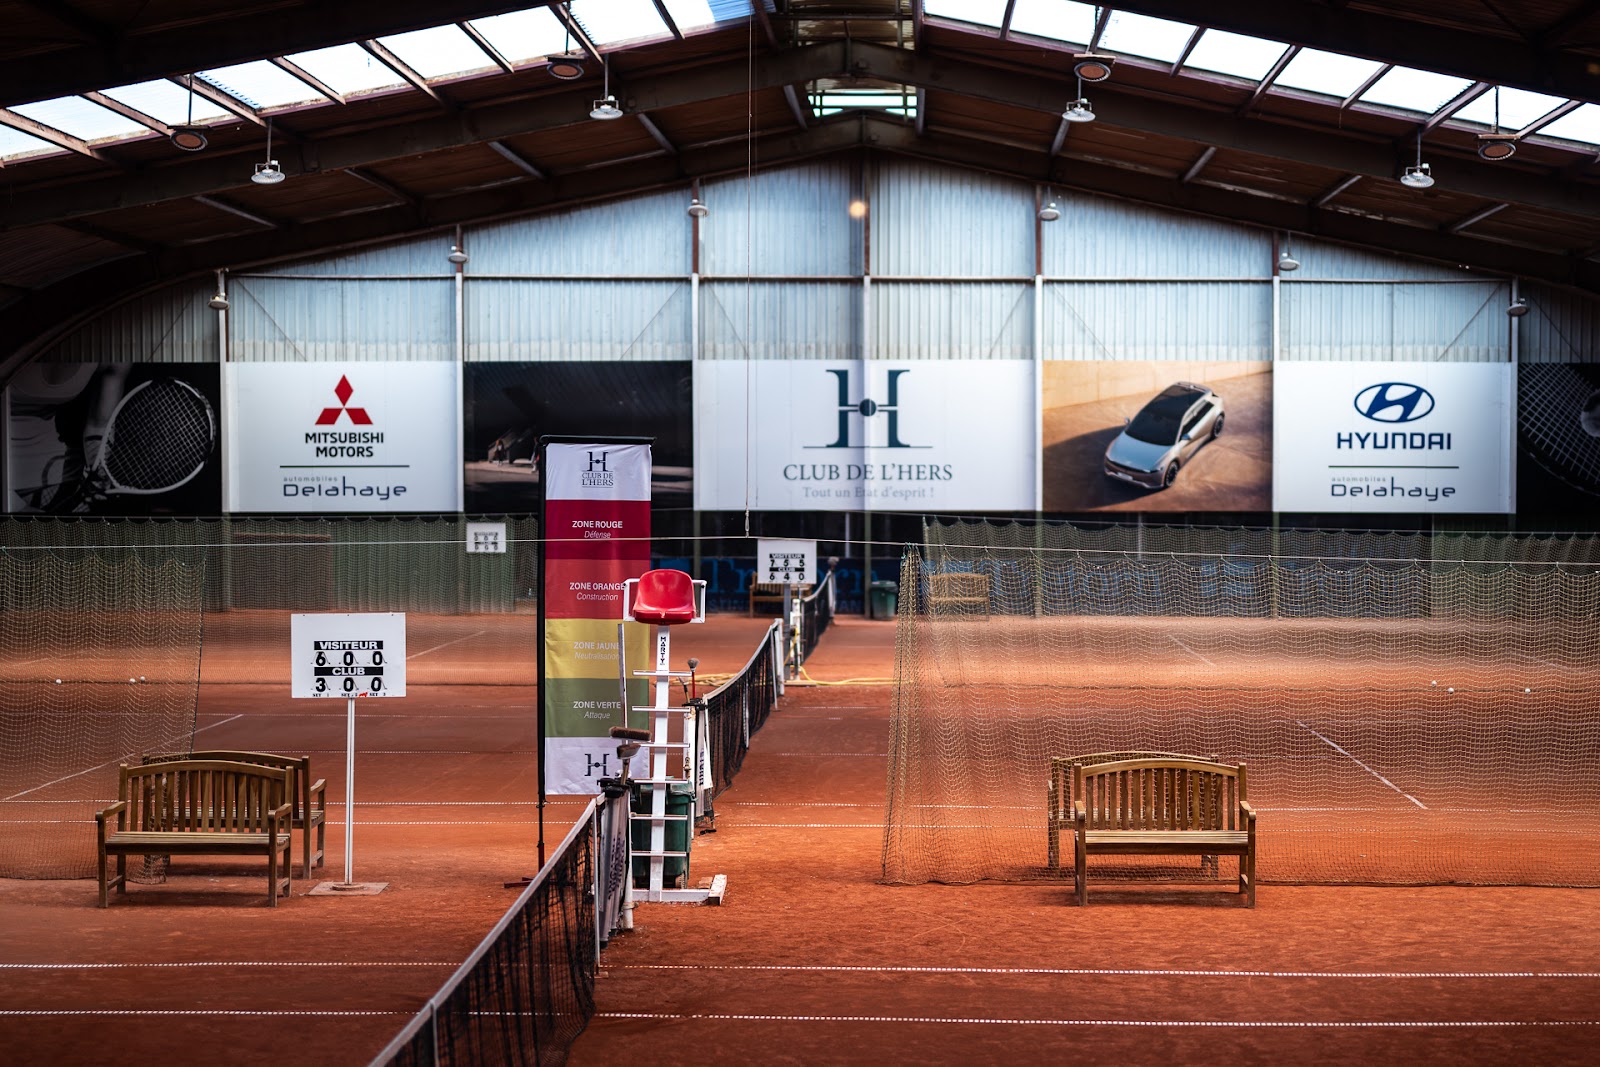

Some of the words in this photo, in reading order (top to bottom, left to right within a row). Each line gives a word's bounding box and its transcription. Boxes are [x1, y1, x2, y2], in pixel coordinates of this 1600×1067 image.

[305, 432, 385, 444] MITSUBISHI
[1336, 432, 1452, 450] HYUNDAI
[315, 446, 374, 458] MOTORS
[581, 472, 601, 480] CLUB
[783, 464, 840, 481] CLUB
[846, 464, 875, 481] DE
[881, 463, 953, 481] L'HERS
[581, 479, 614, 487] L'HERS
[283, 475, 407, 501] Delahaye
[1331, 476, 1457, 502] Delahaye
[803, 486, 831, 498] Tout
[835, 489, 850, 498] un
[881, 486, 927, 501] d'esprit
[572, 520, 594, 529] ZONE
[595, 520, 623, 529] ROUGE
[583, 530, 612, 539] Défense
[569, 582, 593, 591] ZONE
[592, 582, 625, 591] ORANGE
[576, 592, 619, 601] Construction
[319, 641, 378, 650] VISITEUR
[573, 641, 596, 650] ZONE
[315, 651, 326, 666] 6
[343, 651, 354, 666] 0
[372, 651, 383, 666] 0
[332, 667, 366, 676] CLUB
[315, 677, 326, 692] 3
[343, 677, 354, 692] 0
[370, 677, 382, 692] 0
[572, 700, 595, 709] ZONE
[596, 700, 622, 709] VERTE
[583, 711, 611, 720] Attaque
